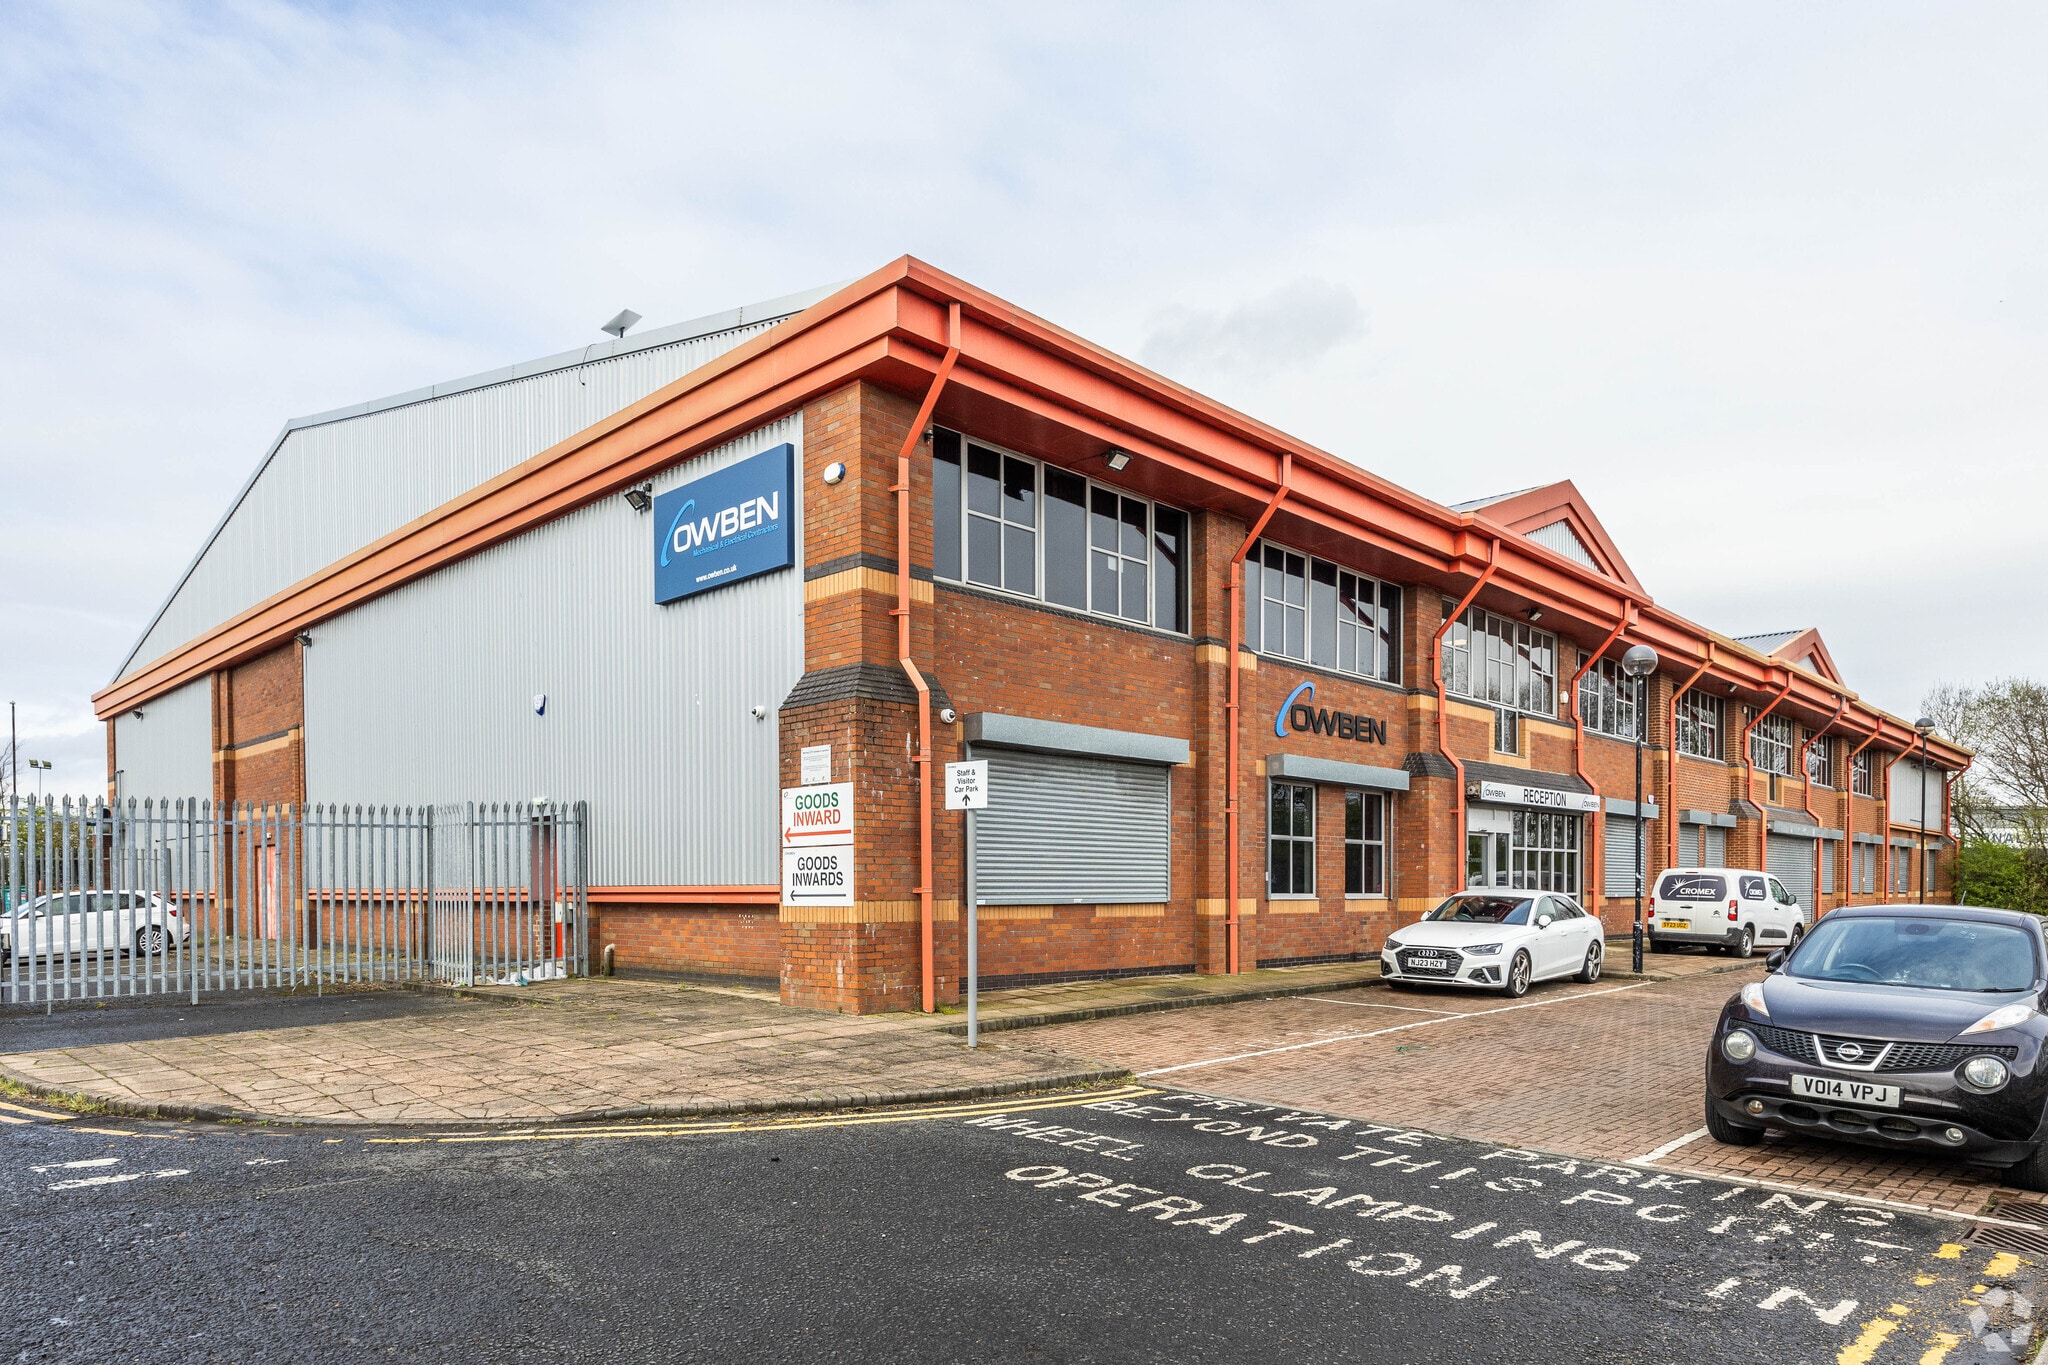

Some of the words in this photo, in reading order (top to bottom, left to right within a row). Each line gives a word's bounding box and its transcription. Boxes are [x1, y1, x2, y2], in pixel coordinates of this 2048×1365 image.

[673, 490, 779, 553] OWBEN
[693, 541, 719, 557] Mechanical
[724, 532, 748, 547] Electrical
[747, 523, 779, 540] Contractors
[696, 563, 737, 583] www.owben.co.uk
[1291, 704, 1386, 745] OWBEN
[956, 769, 970, 777] Staff
[965, 785, 979, 793] Park
[1486, 788, 1506, 798] OWBEN
[1523, 788, 1567, 807] RECEPTION
[795, 791, 839, 811] GOODS
[793, 809, 841, 827] INWARD
[797, 855, 838, 871] GOODS
[792, 871, 844, 887] INWARDS
[1680, 887, 1717, 896] CROMEX
[1749, 888, 1764, 896] CROMEX
[1410, 959, 1429, 967] NJ23
[1429, 960, 1444, 969] HZY
[1804, 1077, 1843, 1097] VO14
[1850, 1084, 1887, 1103] VPJ
[1162, 1093, 1450, 1148] PRIVATE
[1082, 1100, 1318, 1149] BEYOND
[1338, 1145, 1544, 1193] THIS
[964, 1113, 1146, 1162] WHEEL
[1185, 1163, 1641, 1272] CLAMPING
[1705, 1276, 1859, 1326] IN
[1003, 1164, 1499, 1300] OPERATION
